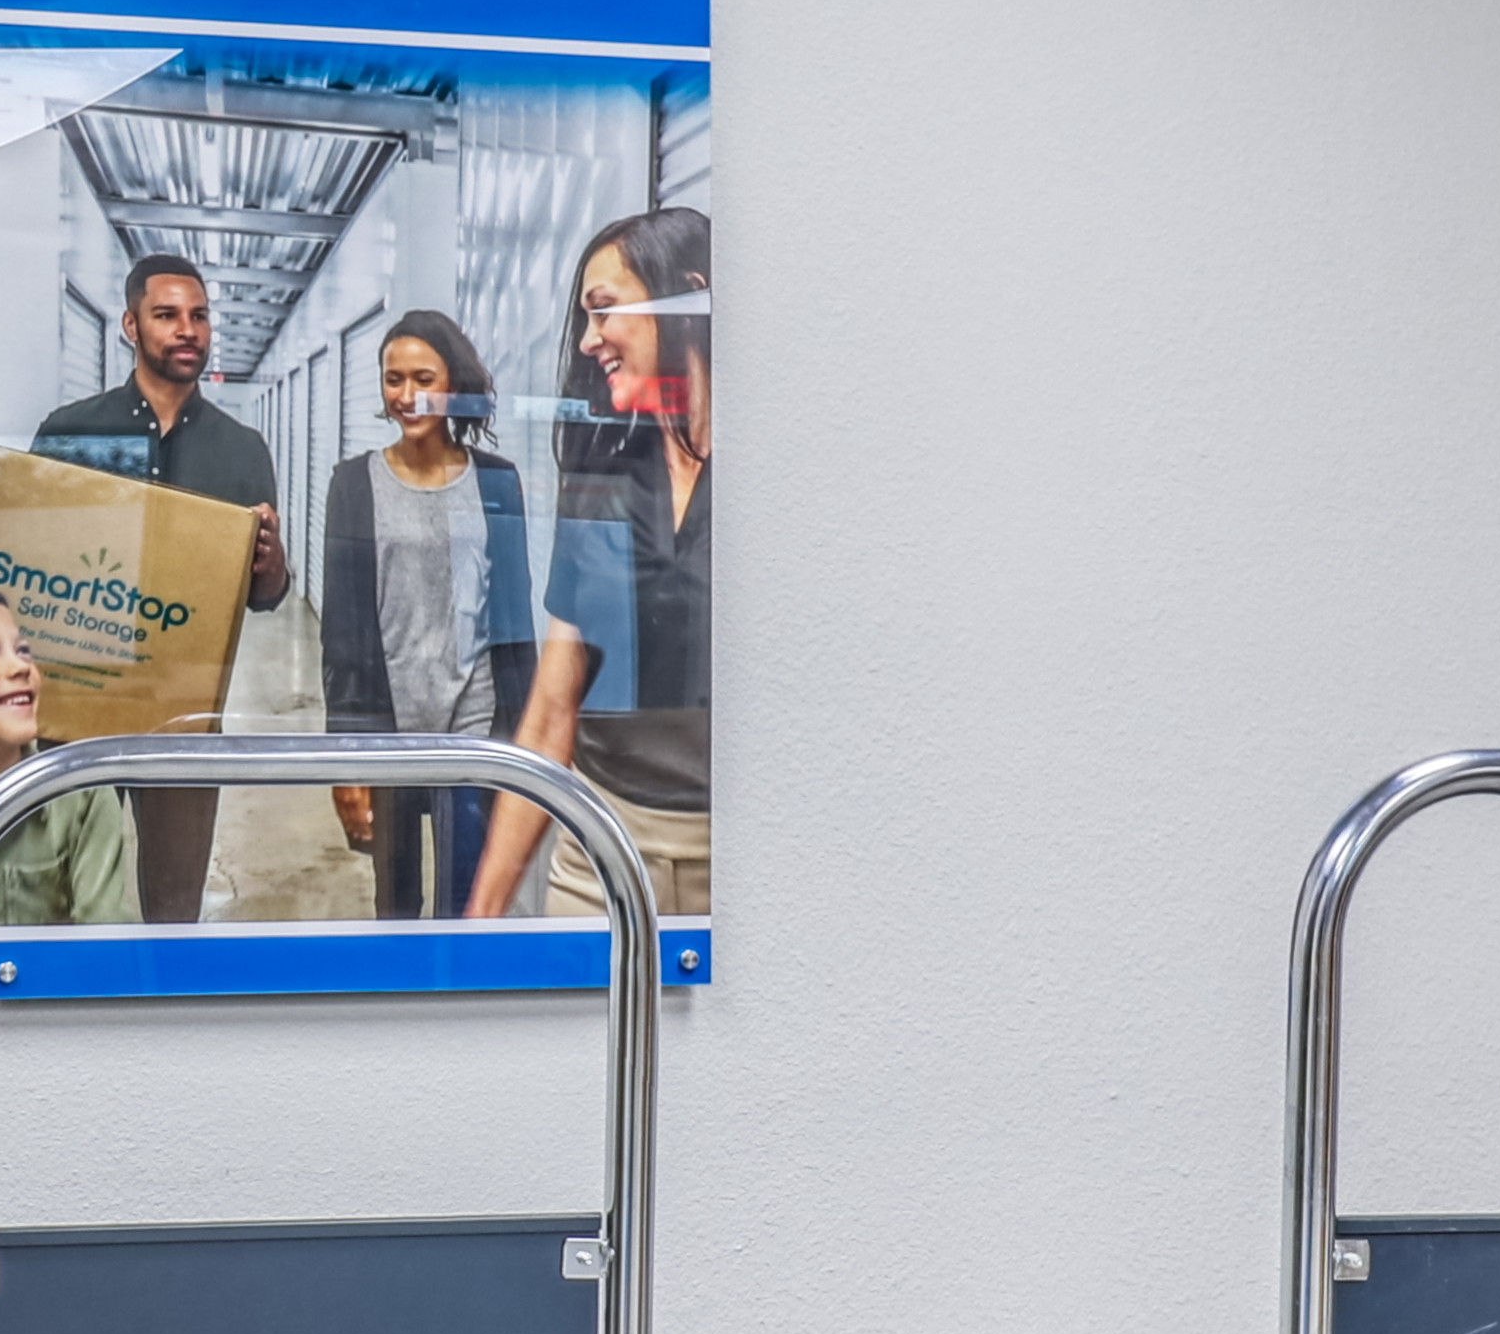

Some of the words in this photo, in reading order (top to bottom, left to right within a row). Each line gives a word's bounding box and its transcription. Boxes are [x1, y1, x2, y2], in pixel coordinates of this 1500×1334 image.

[17, 596, 60, 620] Self
[63, 607, 147, 642] Storage
[37, 630, 76, 646] Smarter
